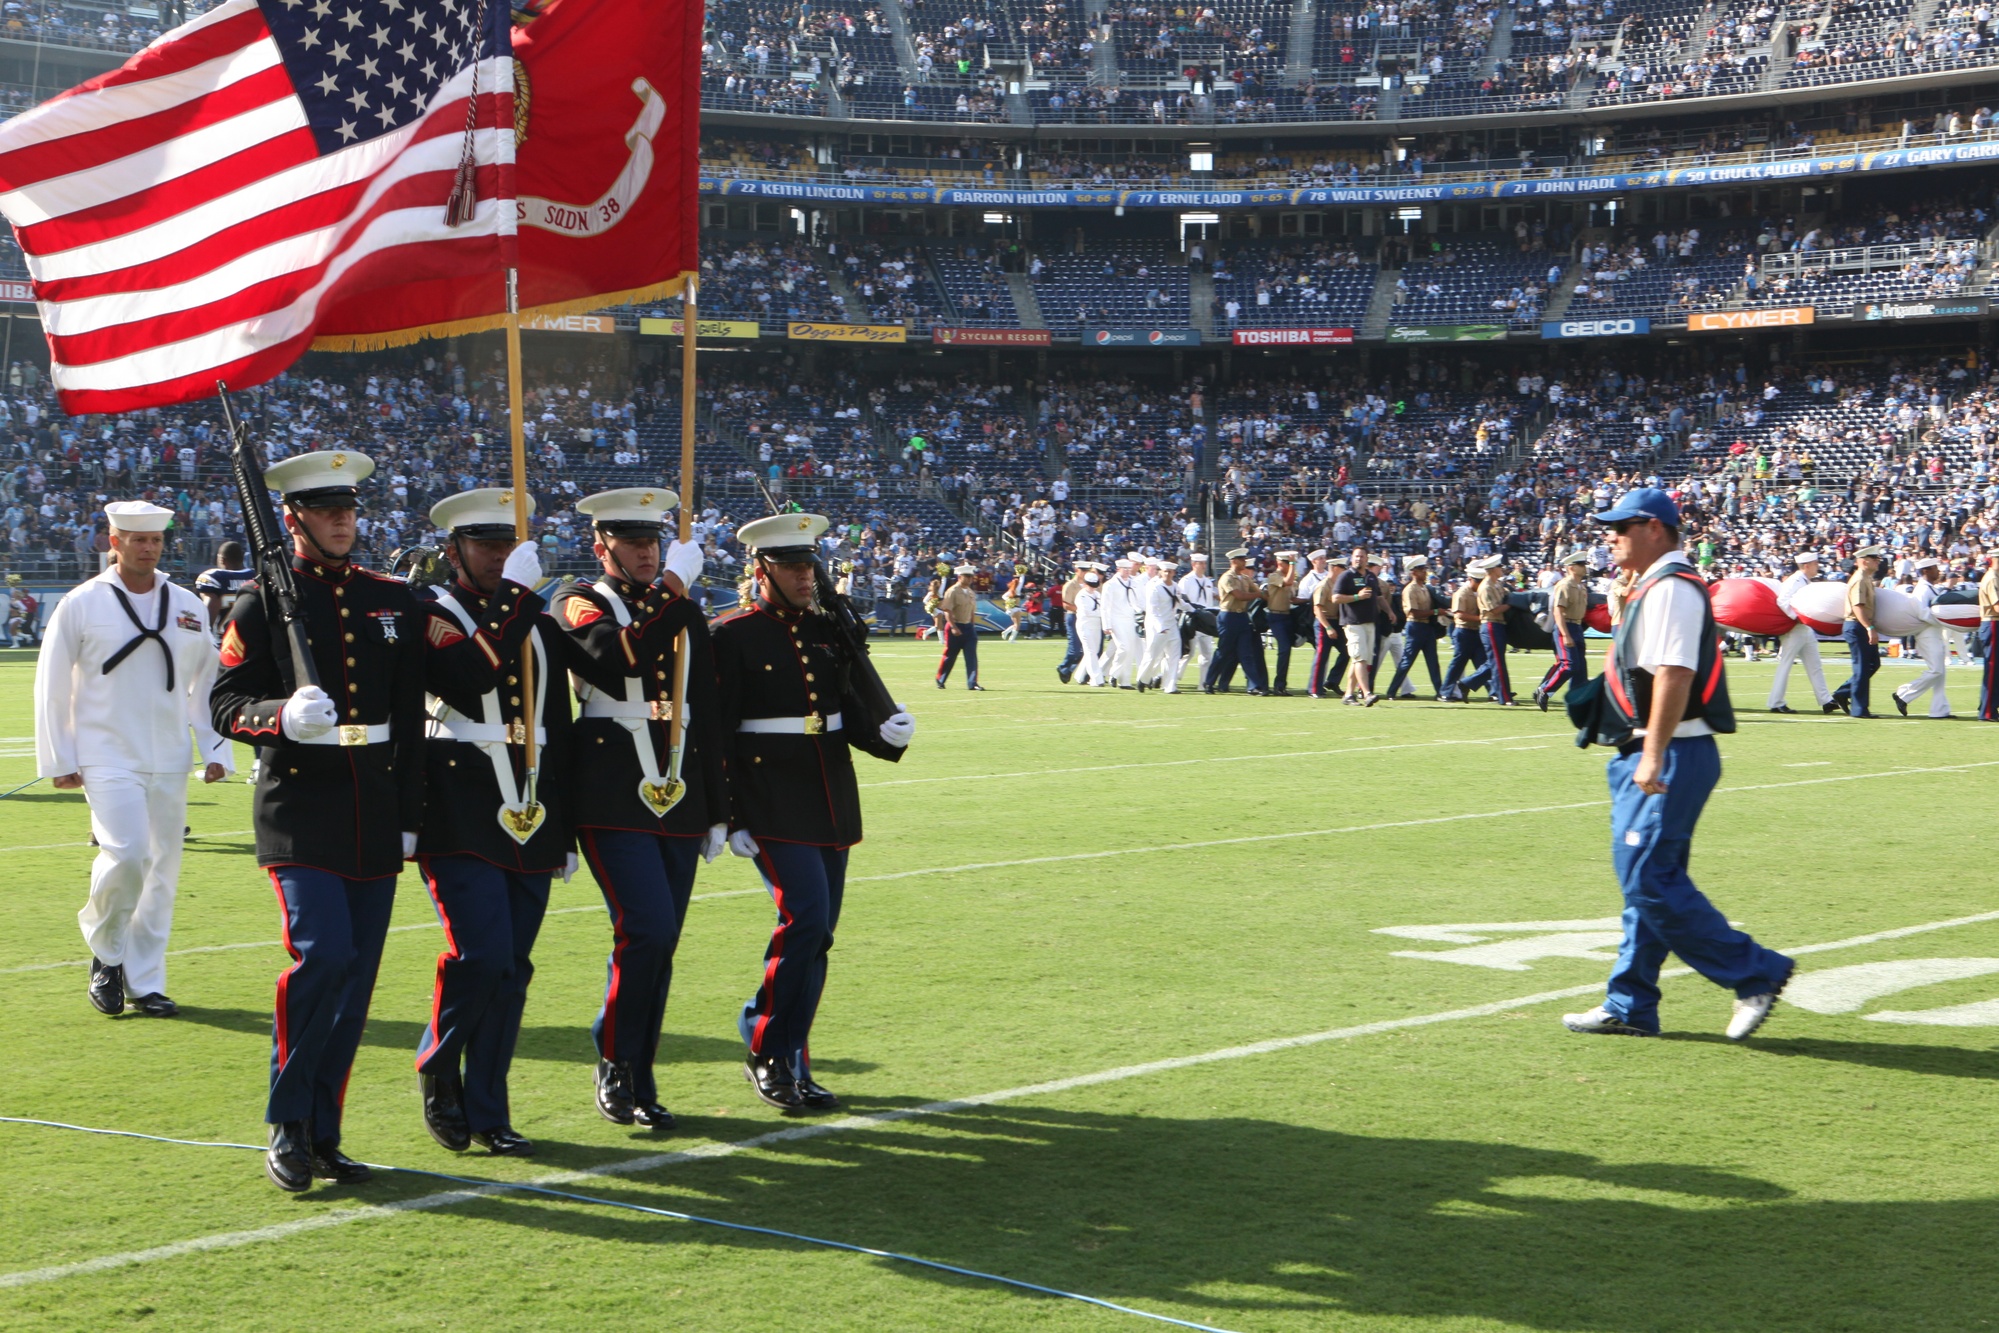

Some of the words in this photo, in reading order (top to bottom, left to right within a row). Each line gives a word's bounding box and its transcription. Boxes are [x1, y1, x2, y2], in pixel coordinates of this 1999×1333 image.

[1884, 153, 1902, 166] 27
[1907, 148, 1955, 164] GARY
[1687, 171, 1705, 182] 50
[1710, 167, 1762, 180] CHUCK
[1763, 162, 1811, 177] ALLEN
[741, 183, 756, 193] 22
[762, 184, 802, 196] KEITH
[806, 186, 864, 200] LINCOLN
[1513, 184, 1527, 194] 21
[1533, 182, 1574, 194] JOHN
[1578, 178, 1617, 191] HADL
[953, 192, 1014, 204] BARRON
[1016, 193, 1067, 204] HILTON
[1138, 194, 1154, 204] 77
[1159, 193, 1201, 205] ERNIE
[1204, 193, 1242, 205] LADD
[1310, 191, 1326, 202] 78
[1331, 190, 1372, 201] WALT
[1374, 187, 1443, 202] SWEENEY
[545, 205, 589, 231] SQDN
[599, 197, 620, 223] 38
[1701, 308, 1800, 329] CYMER
[1935, 306, 1979, 316] SEAFOOD
[792, 324, 847, 339] Oggi's
[848, 326, 901, 341] Pizza
[1560, 319, 1636, 337] GEICO
[960, 332, 1002, 341] SYCUAN
[1007, 333, 1048, 342] RESORT
[1111, 334, 1134, 342] pepsi
[1164, 334, 1187, 342] pepsi
[1237, 330, 1310, 344] TOSHIBA
